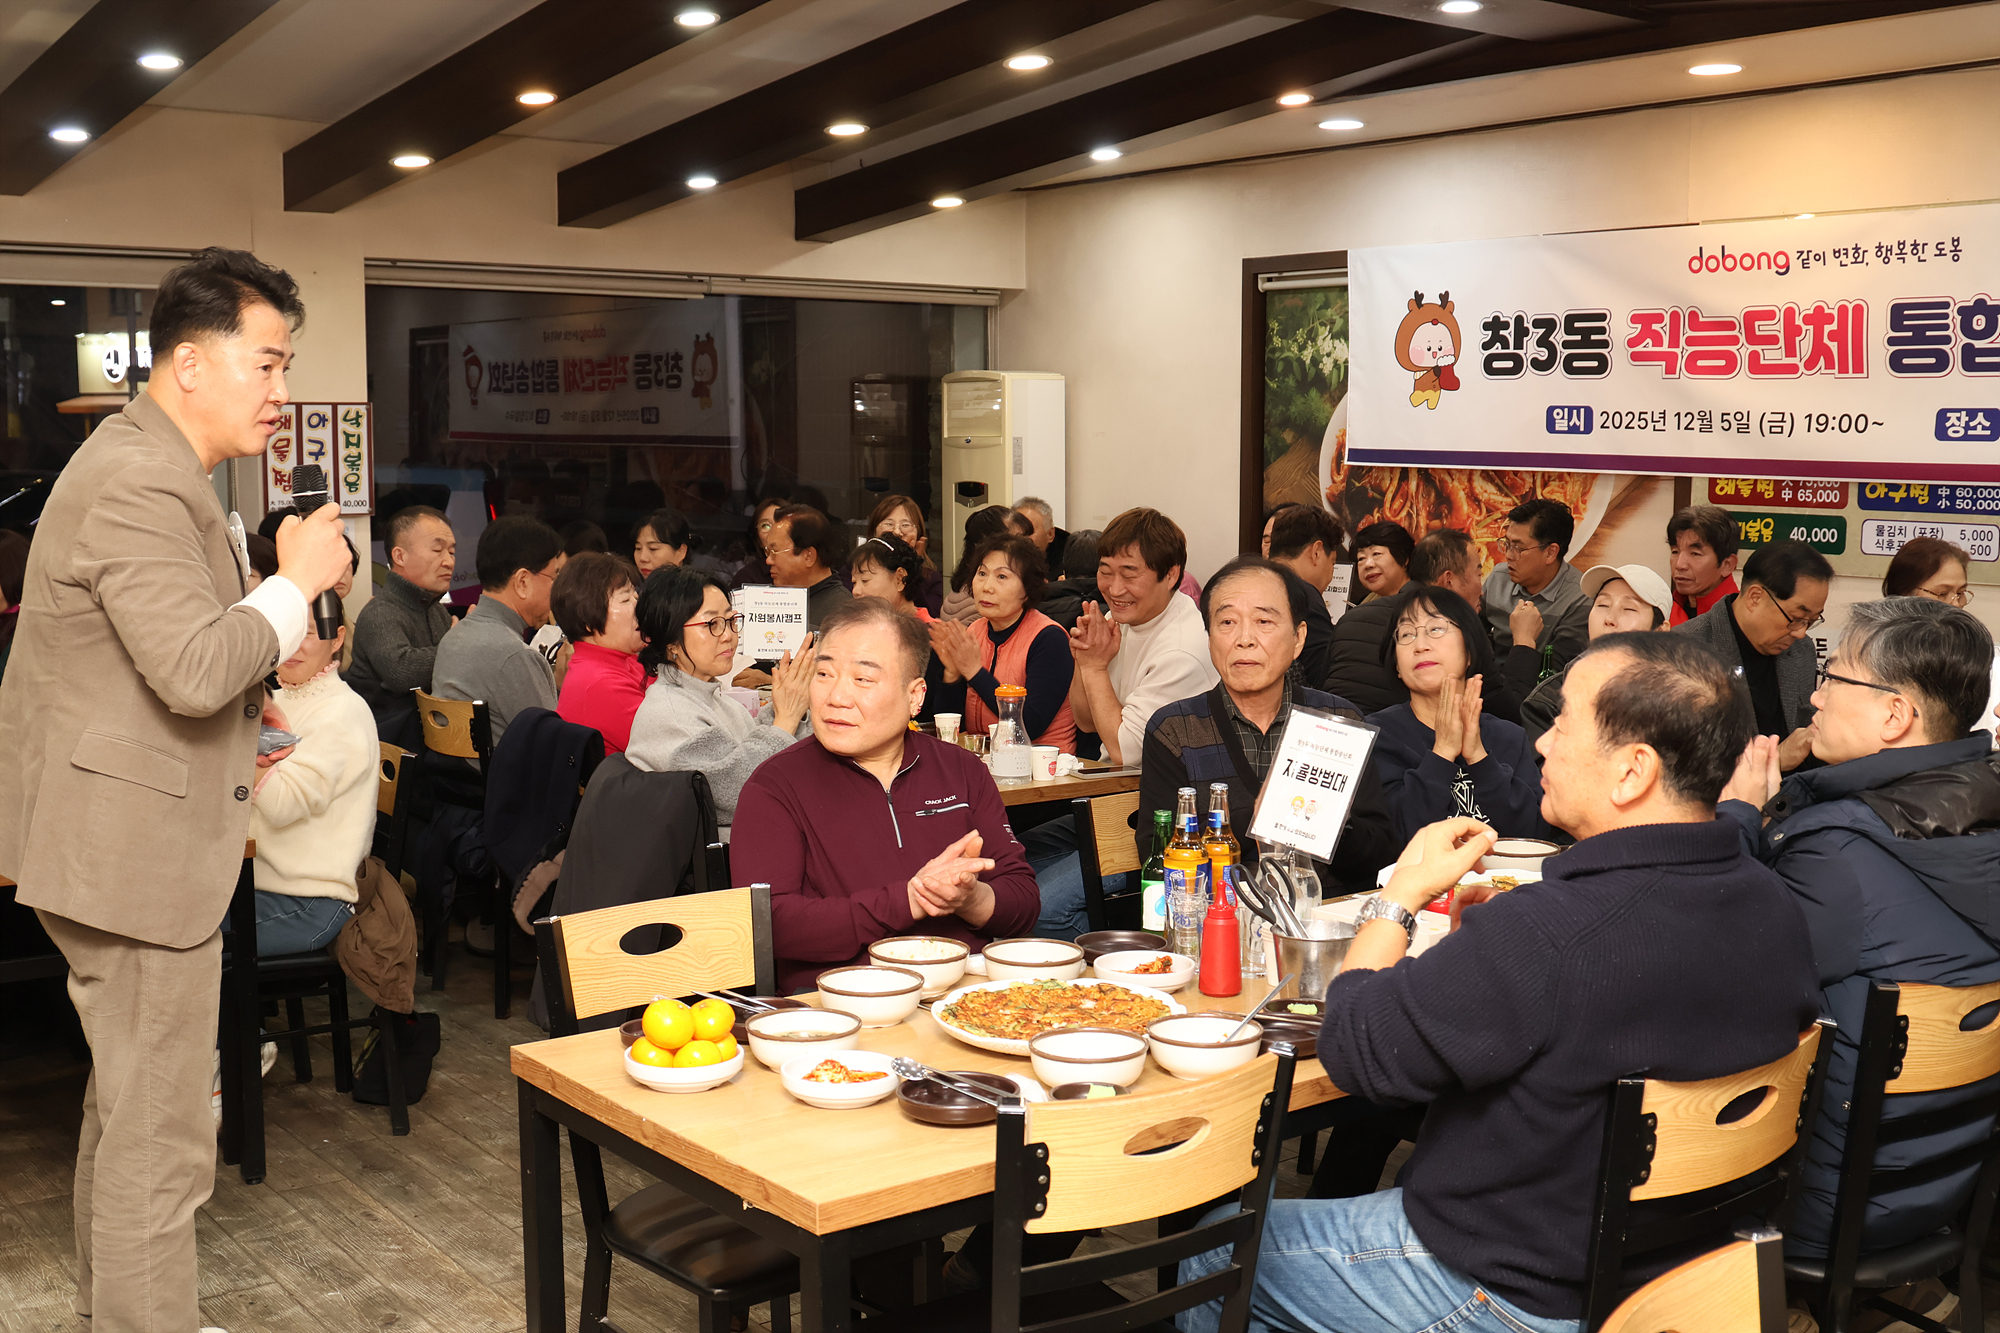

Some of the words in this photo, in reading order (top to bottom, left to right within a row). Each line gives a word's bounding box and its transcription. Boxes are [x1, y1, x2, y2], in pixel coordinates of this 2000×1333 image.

[1688, 245, 1790, 276] dobong
[1796, 250, 1826, 269] 같이
[1833, 243, 1869, 267] 변화,
[1875, 239, 1928, 265] 행복한
[1933, 236, 1963, 263] 도봉
[1480, 309, 1612, 378] 창3동
[1624, 301, 1870, 379] 직능단체
[1552, 406, 1586, 431] 일시
[1600, 409, 1667, 432] 2025년
[1673, 409, 1714, 434] 12월
[1720, 411, 1751, 434] 5일
[1758, 411, 1795, 438] (금)
[1804, 413, 1885, 434] 19:00~
[1945, 411, 1992, 438] 장소
[307, 413, 329, 488] 아구
[1781, 488, 1793, 502] 中
[1797, 489, 1840, 503] 65,000
[1938, 486, 1950, 498] 中
[1955, 487, 2000, 499] 60,000
[343, 500, 367, 508] 40,000
[1937, 499, 1950, 509] 小
[1955, 499, 2000, 511] 50,000
[1789, 527, 1838, 543] 40,000
[1875, 525, 1907, 538] 물김치
[1959, 529, 1993, 542] 5,000
[748, 612, 802, 623] 자원봉사캠프
[1282, 758, 1349, 793] 자율방범대
[925, 798, 942, 806] CRACK
[943, 795, 957, 803] JACK
